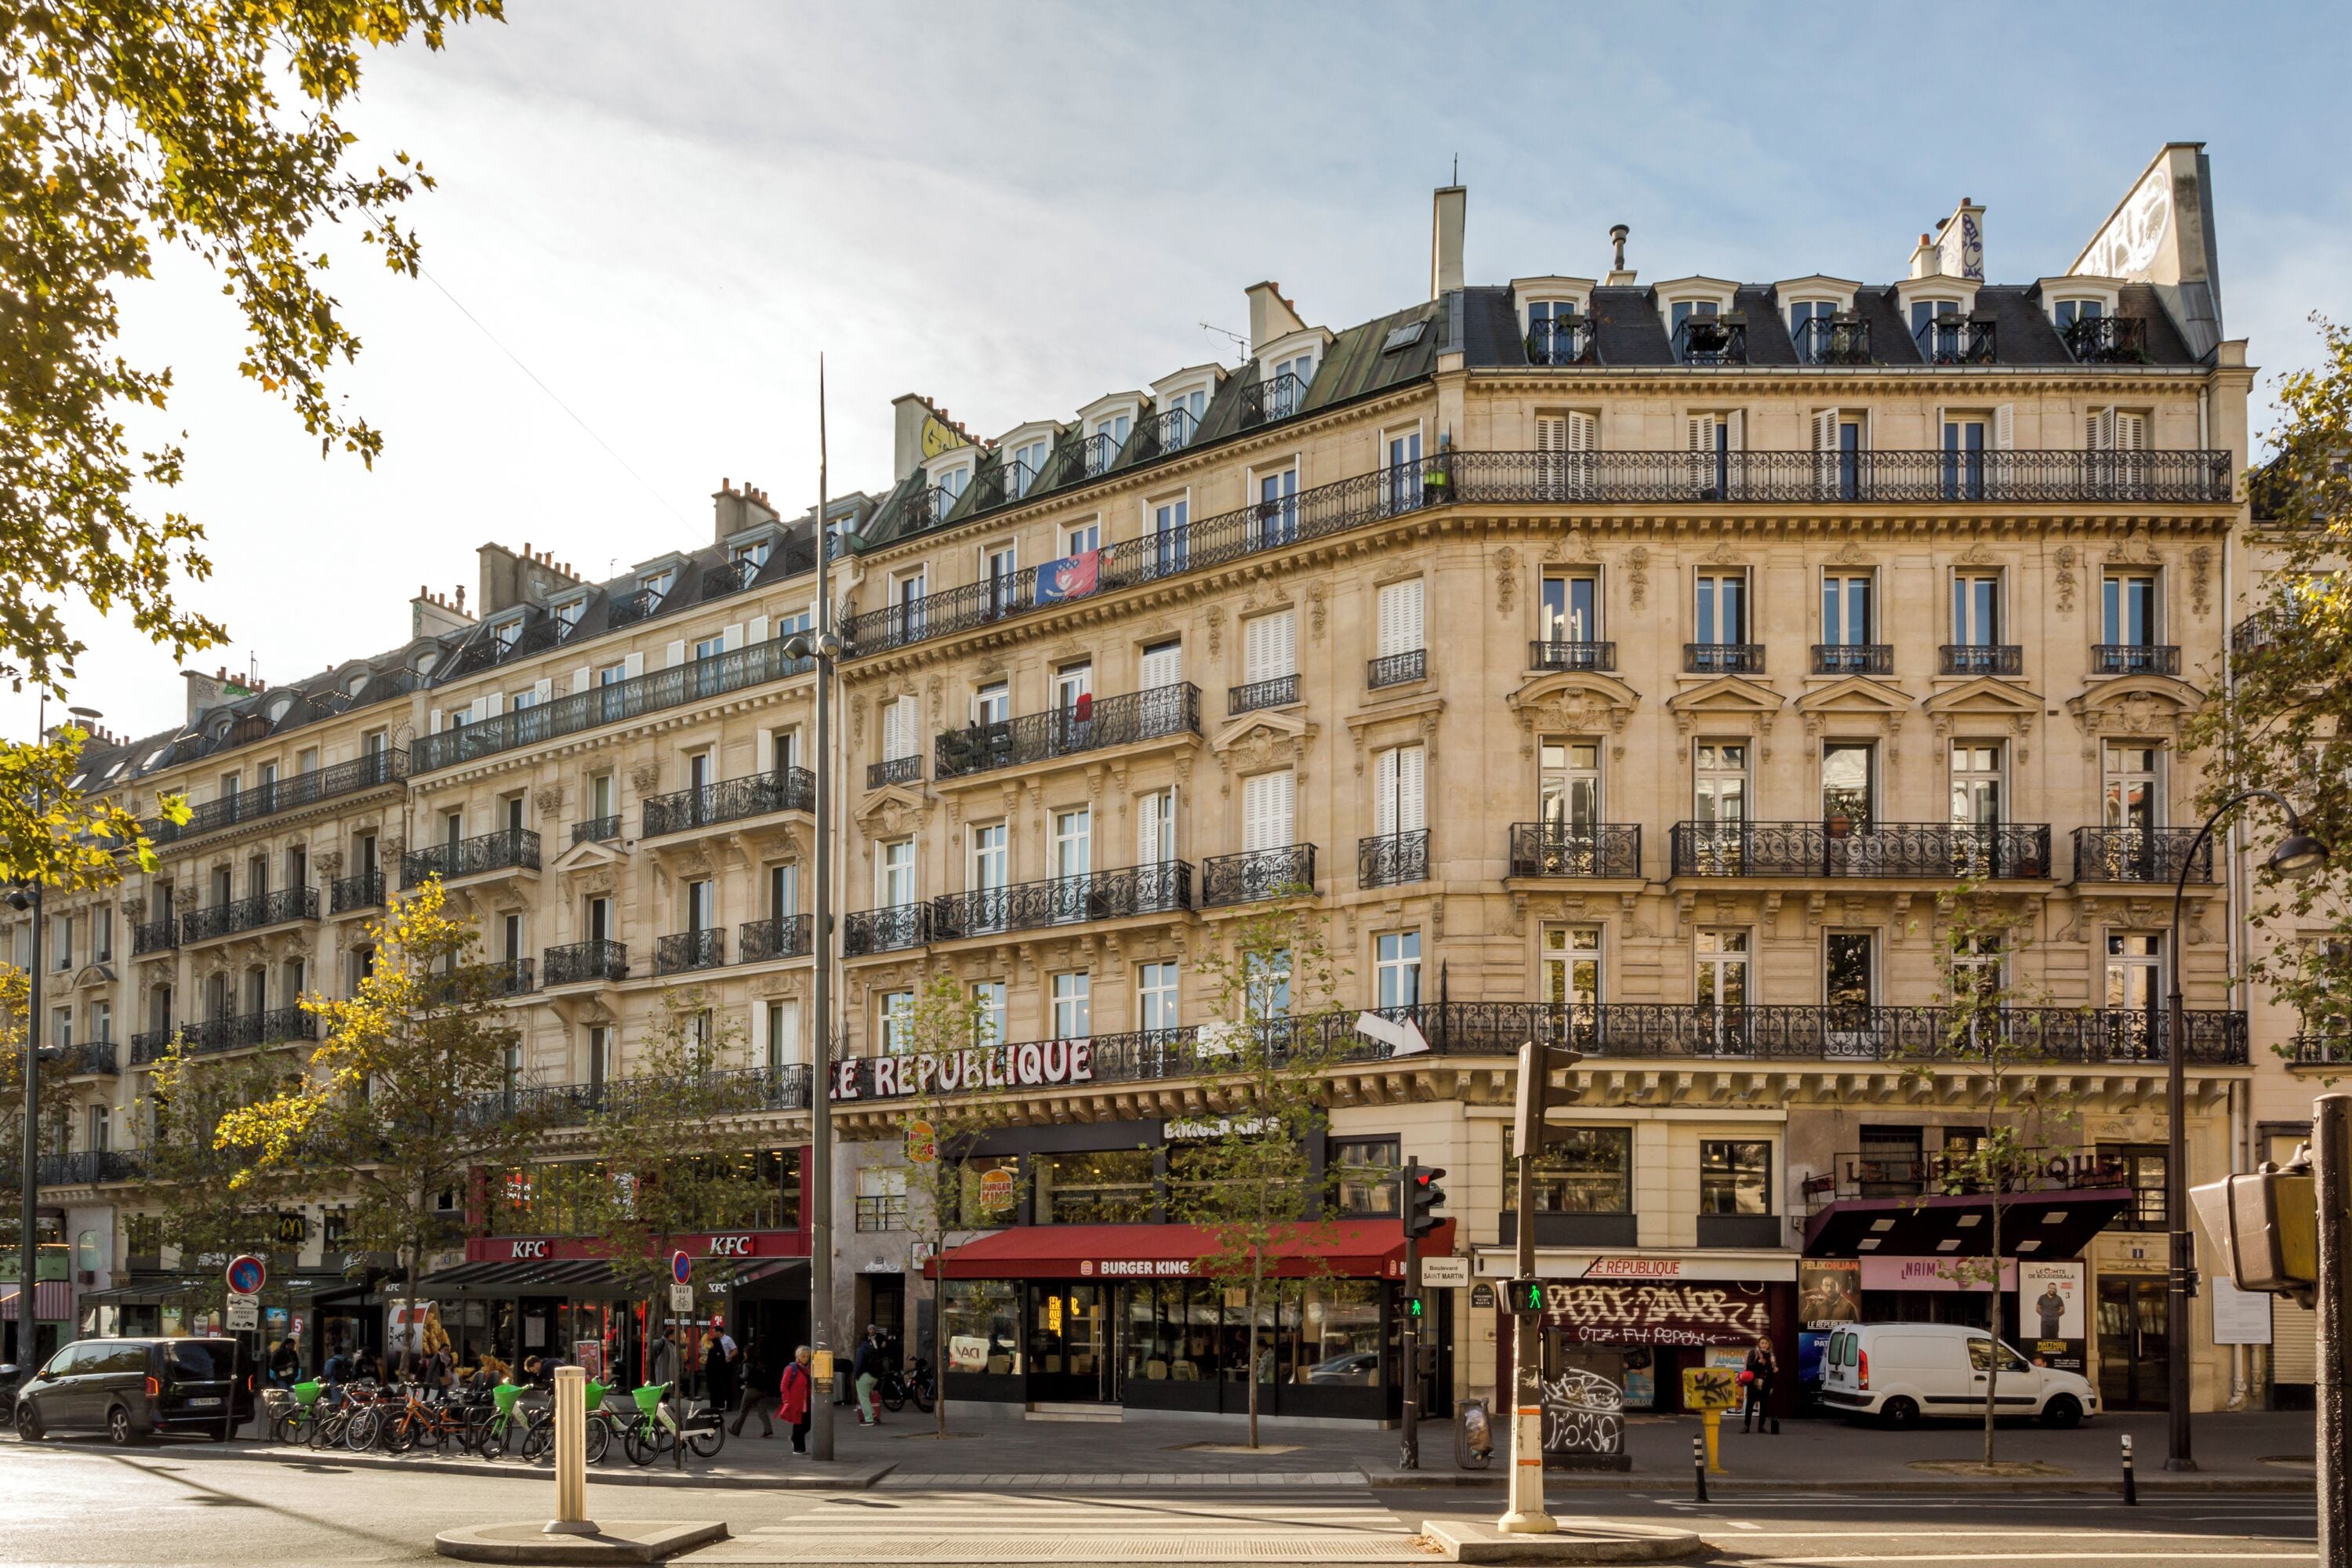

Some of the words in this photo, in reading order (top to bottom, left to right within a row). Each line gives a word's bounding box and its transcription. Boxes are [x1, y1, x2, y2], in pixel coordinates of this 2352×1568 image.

[511, 1240, 546, 1258] KFC
[709, 1236, 750, 1255] KFC
[1101, 1261, 1153, 1275] BURGER
[1156, 1261, 1190, 1275] KING
[1588, 1260, 1604, 1273] LE
[385, 1283, 401, 1292] KFC
[708, 1283, 728, 1293] KFC
